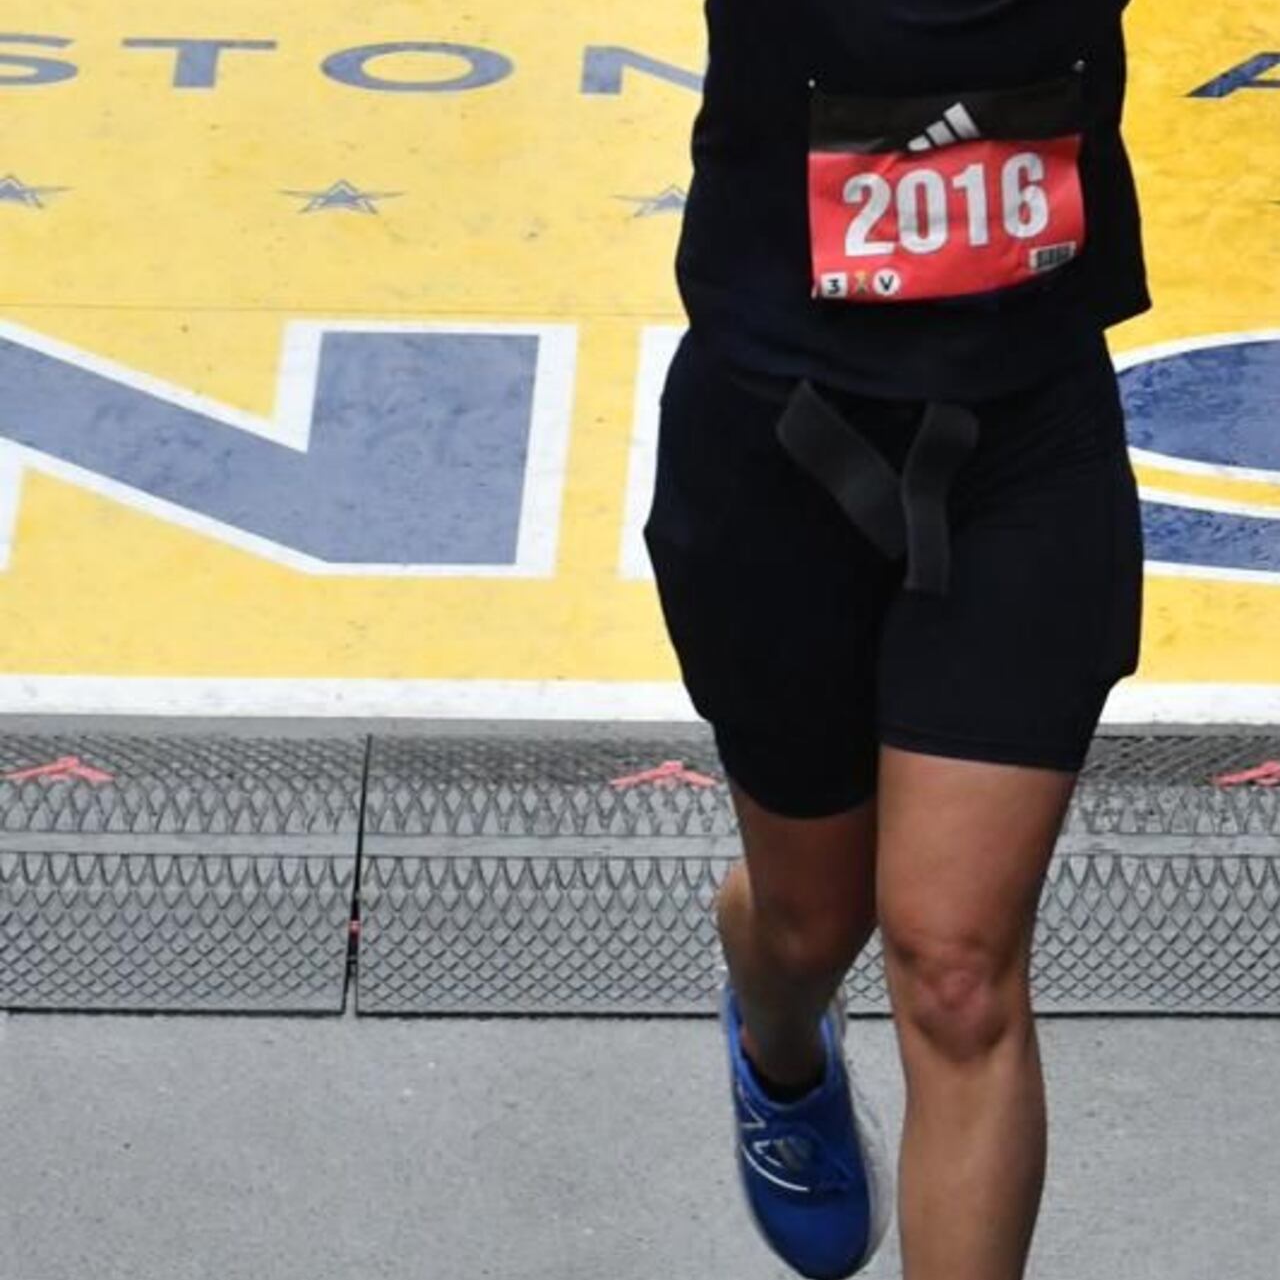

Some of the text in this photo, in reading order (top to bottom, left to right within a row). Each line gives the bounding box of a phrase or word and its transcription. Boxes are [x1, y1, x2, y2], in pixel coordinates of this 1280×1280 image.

[842, 151, 1050, 258] 2016
[826, 273, 895, 296] 3 V
